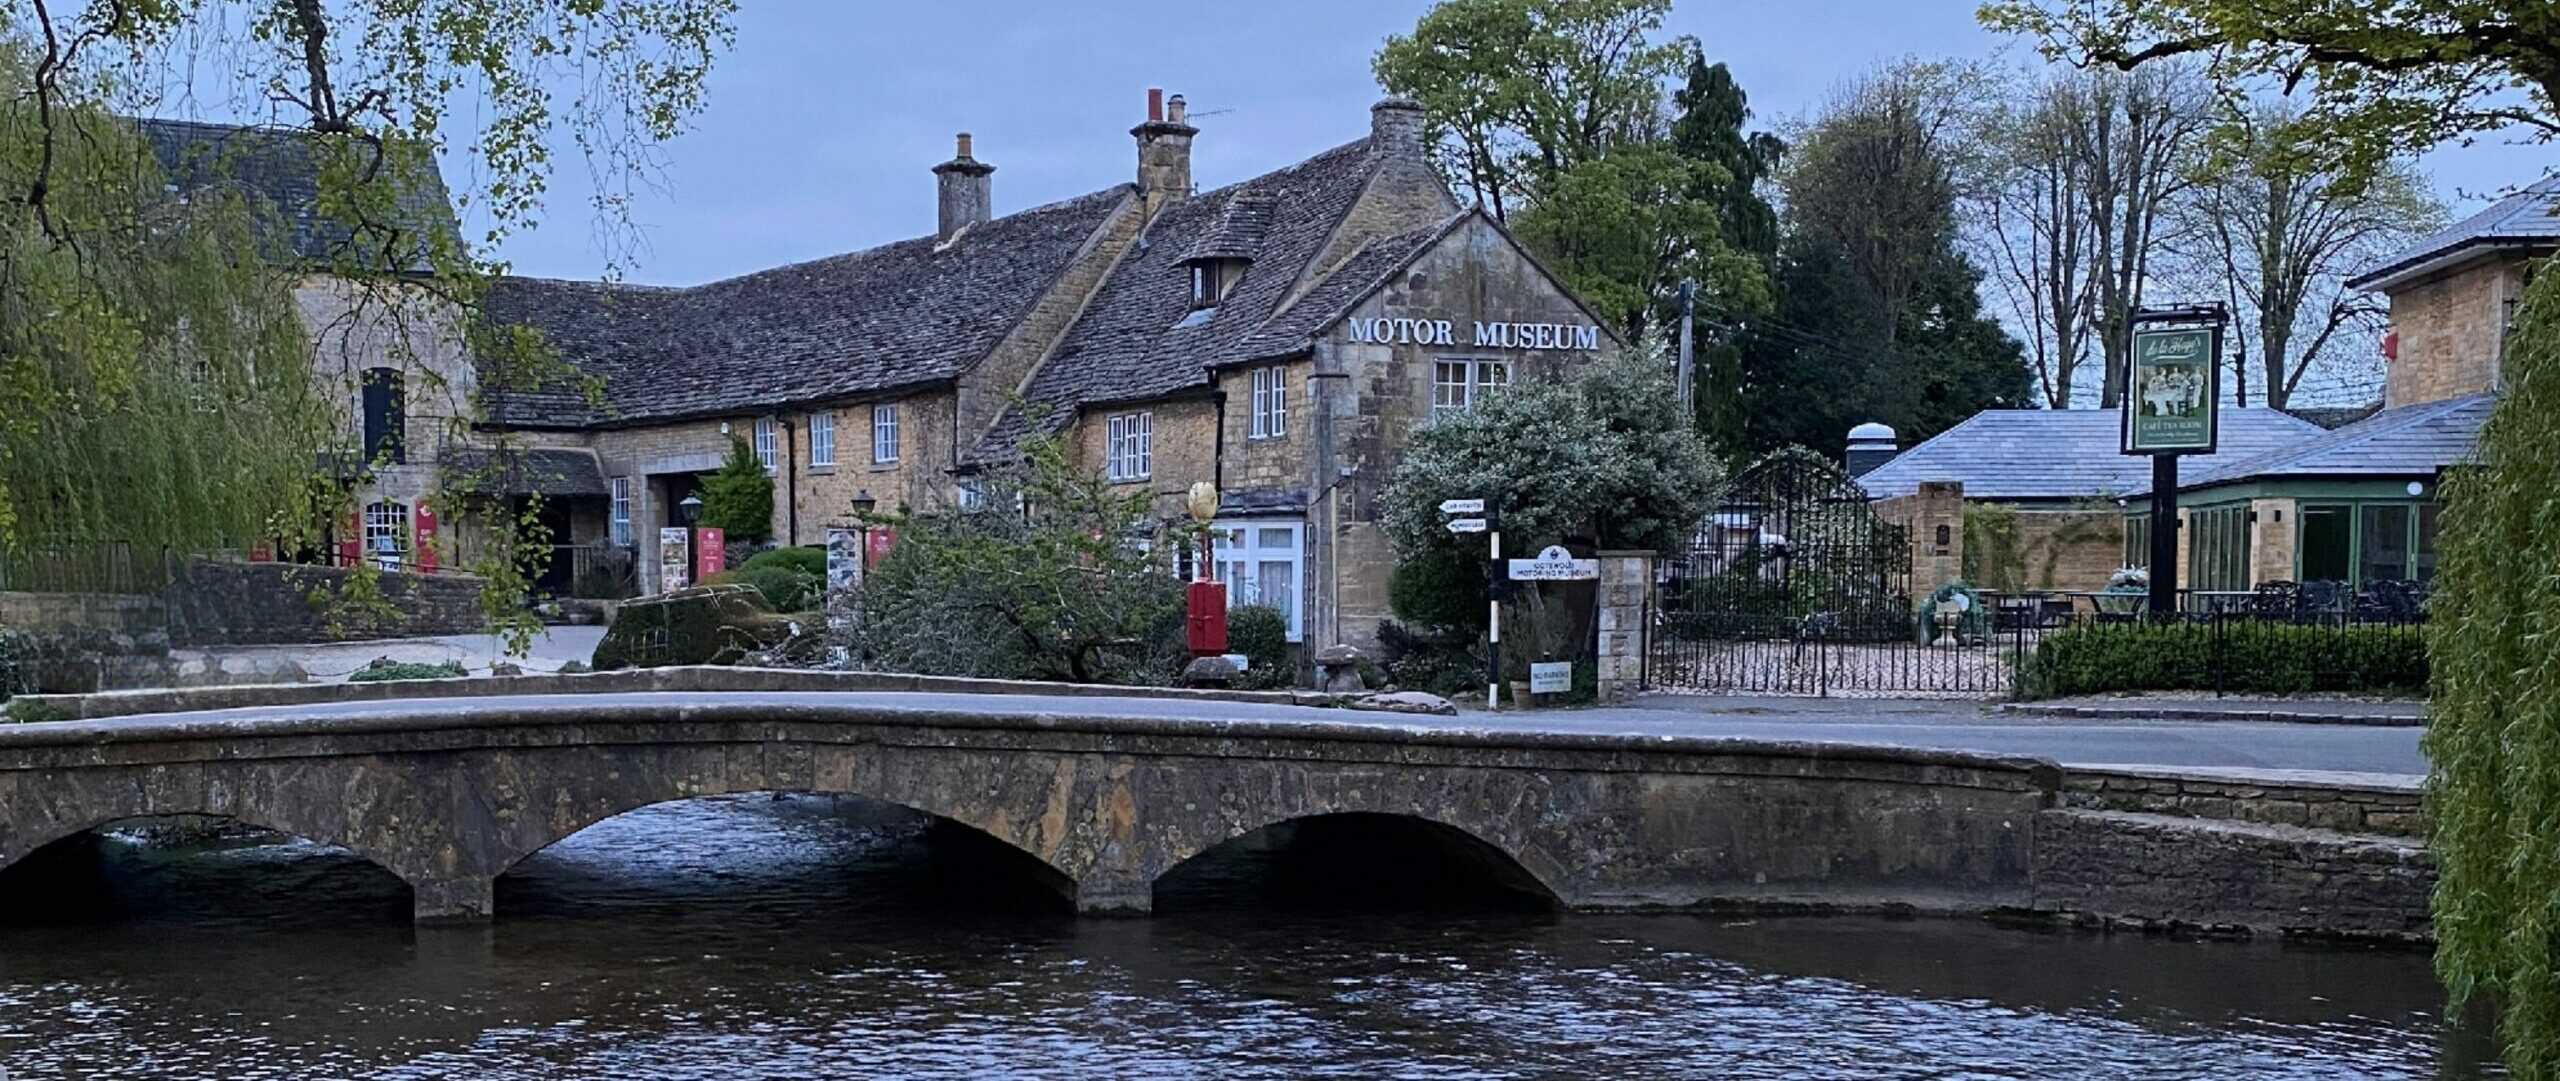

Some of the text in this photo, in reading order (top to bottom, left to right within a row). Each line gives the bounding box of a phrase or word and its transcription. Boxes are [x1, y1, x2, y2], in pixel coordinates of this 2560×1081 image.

[1349, 318, 1600, 350] MOTOR MUSEUM
[1557, 569, 1592, 577] MUSEUM
